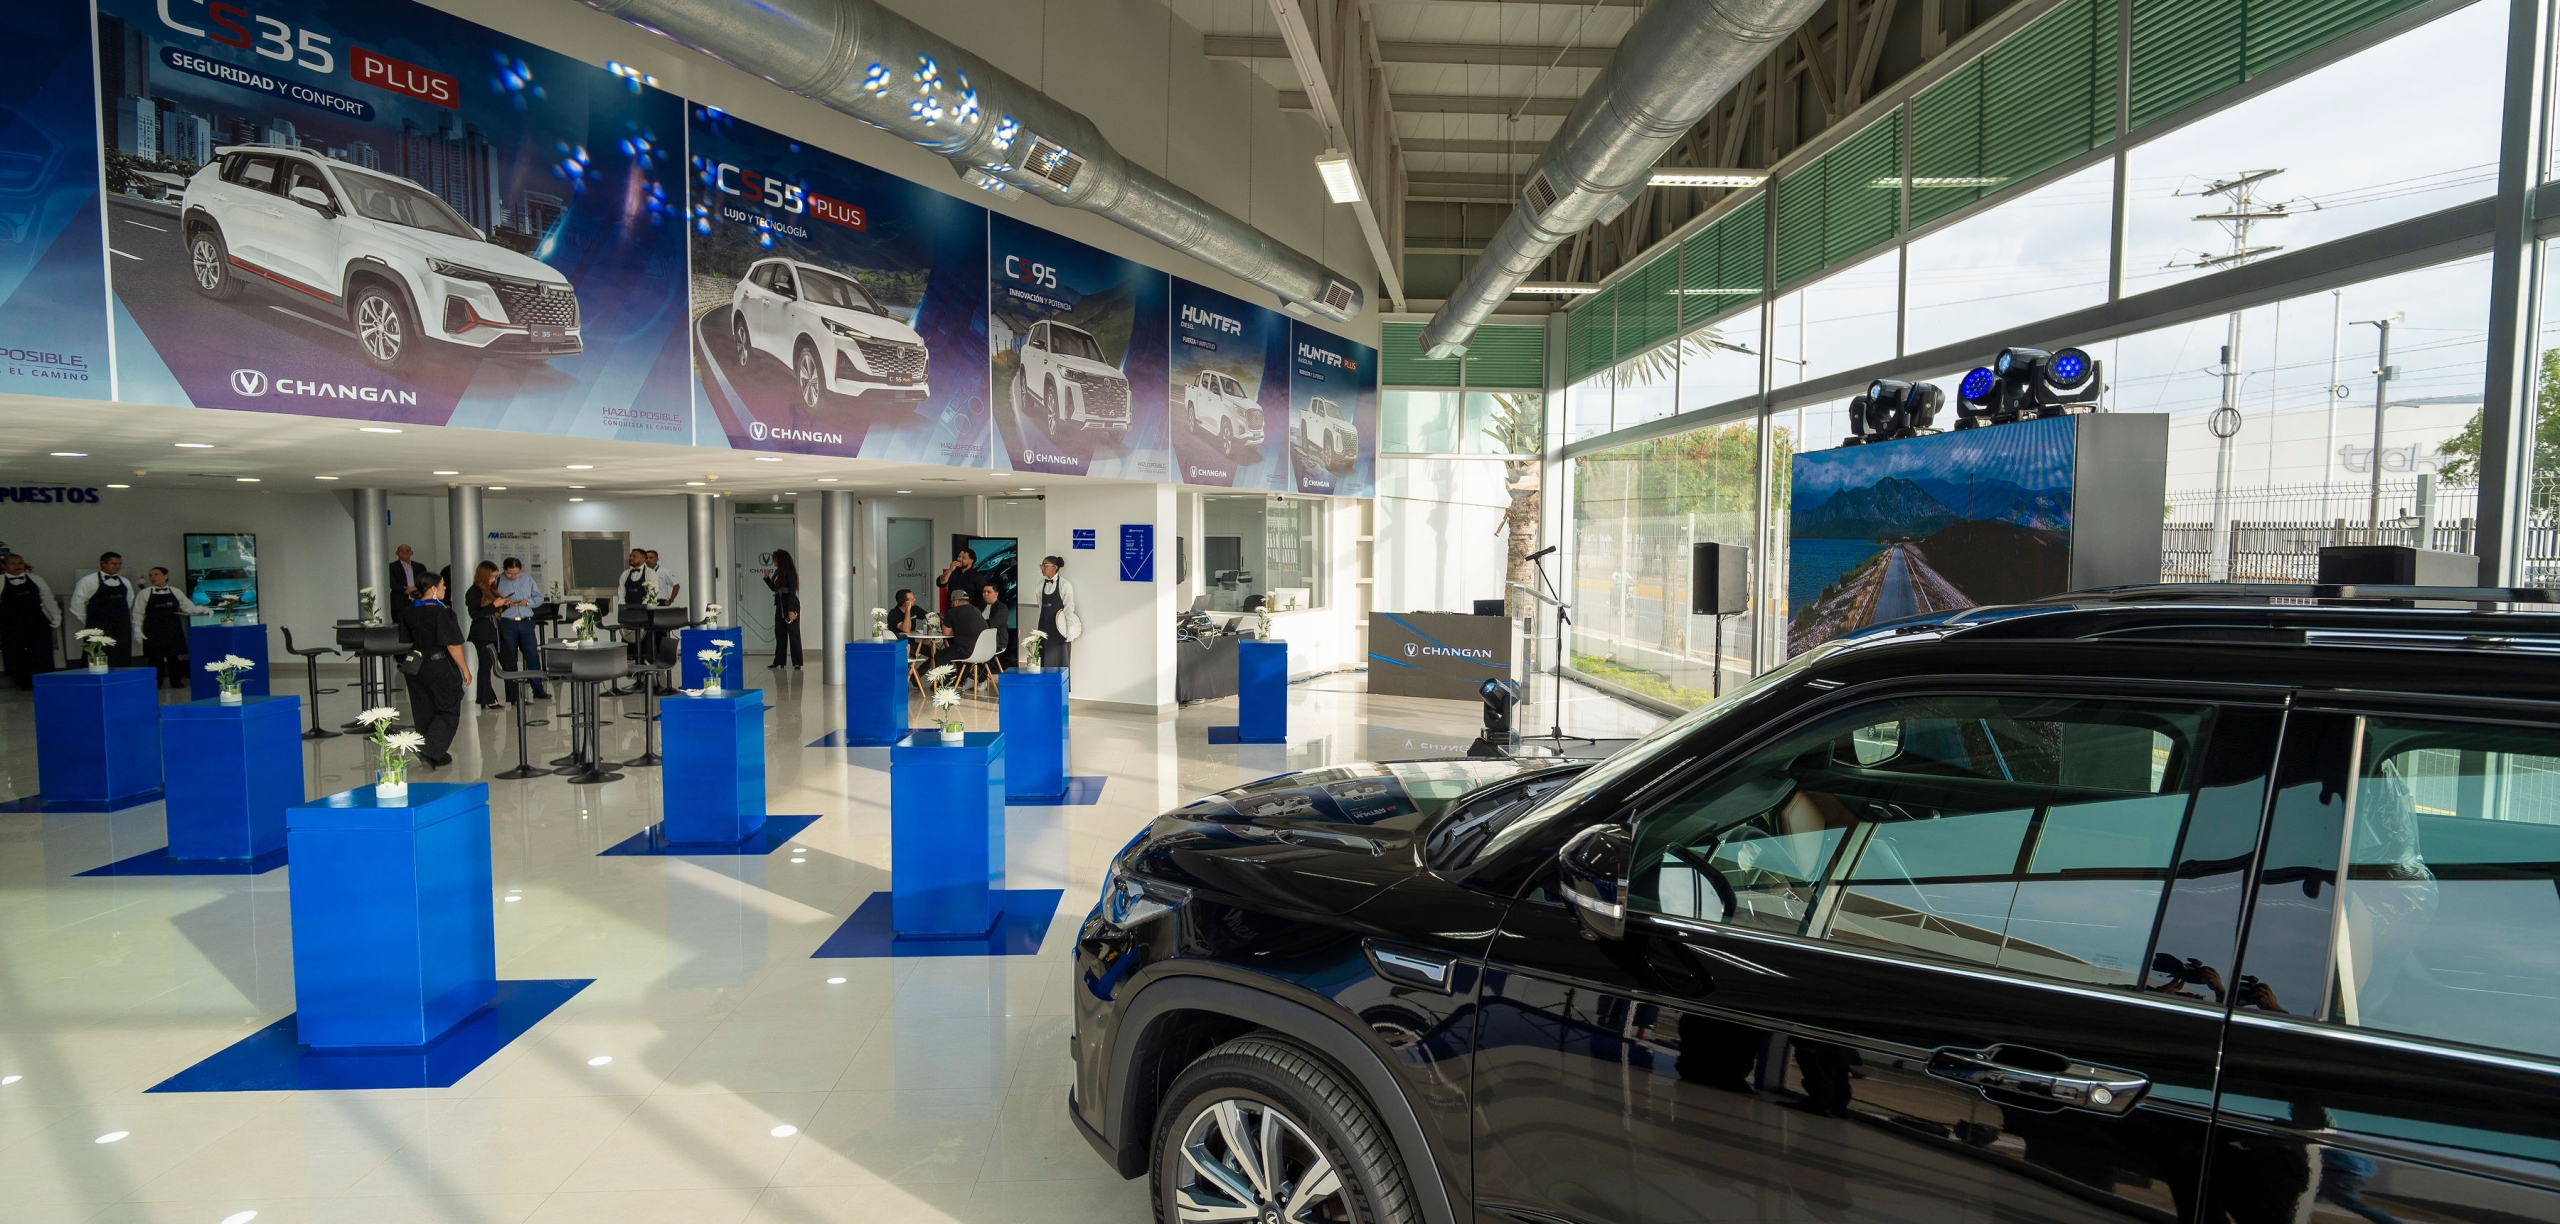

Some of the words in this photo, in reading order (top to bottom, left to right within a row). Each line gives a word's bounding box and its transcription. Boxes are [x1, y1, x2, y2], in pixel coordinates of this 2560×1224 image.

[157, 0, 334, 74] CS35
[365, 57, 450, 101] PLUS
[172, 52, 274, 91] SEGURIDAD
[277, 81, 288, 95] Y
[291, 86, 364, 116] CONFORT
[717, 162, 803, 214] CS55
[817, 199, 861, 226] PLUS
[724, 207, 746, 221] LUJO
[747, 213, 754, 222] Y
[754, 215, 808, 239] TECNOLOGÍA
[1006, 254, 1057, 289] CS95
[1009, 287, 1044, 304] INNOVACIÓN
[1048, 298, 1072, 311] POTENCIA
[1181, 304, 1242, 336] HUNTER
[0, 347, 88, 369] POSIBLE,
[1298, 342, 1342, 368] HUNTER
[9, 367, 24, 375] EL
[31, 369, 89, 381] CAMINO
[276, 379, 417, 405] CHANGAN
[602, 406, 638, 418] HAZLO
[603, 419, 644, 429] CONQUISTA
[771, 427, 843, 444] CHANGAN
[1035, 453, 1078, 465] CHANGAN
[2339, 442, 2454, 473] trak
[1198, 468, 1227, 478] CHANGAN
[1308, 479, 1330, 488] CHANGAN
[0, 486, 99, 503] PUESTOS
[1422, 646, 1492, 658] CHANGAN
